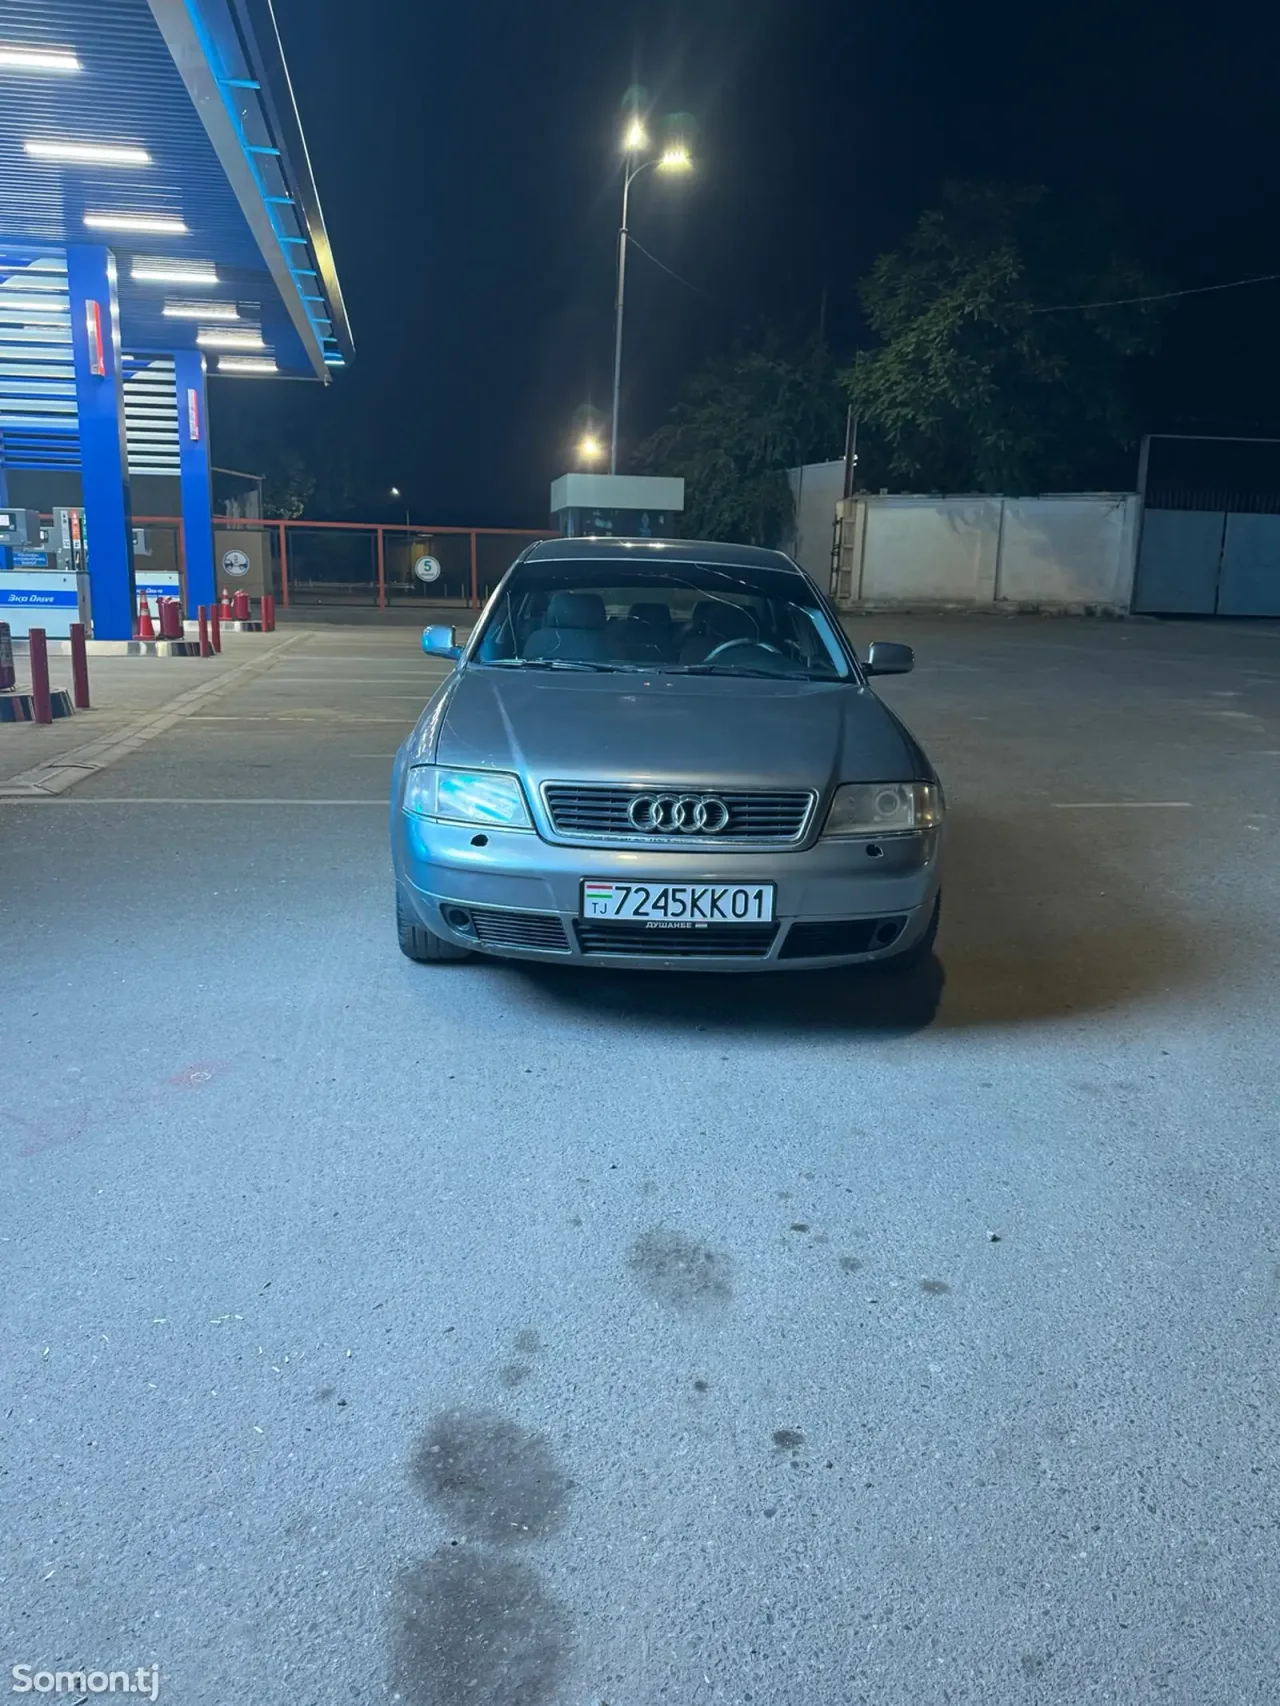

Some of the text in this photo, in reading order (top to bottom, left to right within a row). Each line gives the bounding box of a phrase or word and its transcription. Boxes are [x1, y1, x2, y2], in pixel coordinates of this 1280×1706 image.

[424, 560, 432, 571] 5
[592, 886, 763, 918] TJ 7245KK01
[645, 921, 692, 929] ДУШАНБЕ
